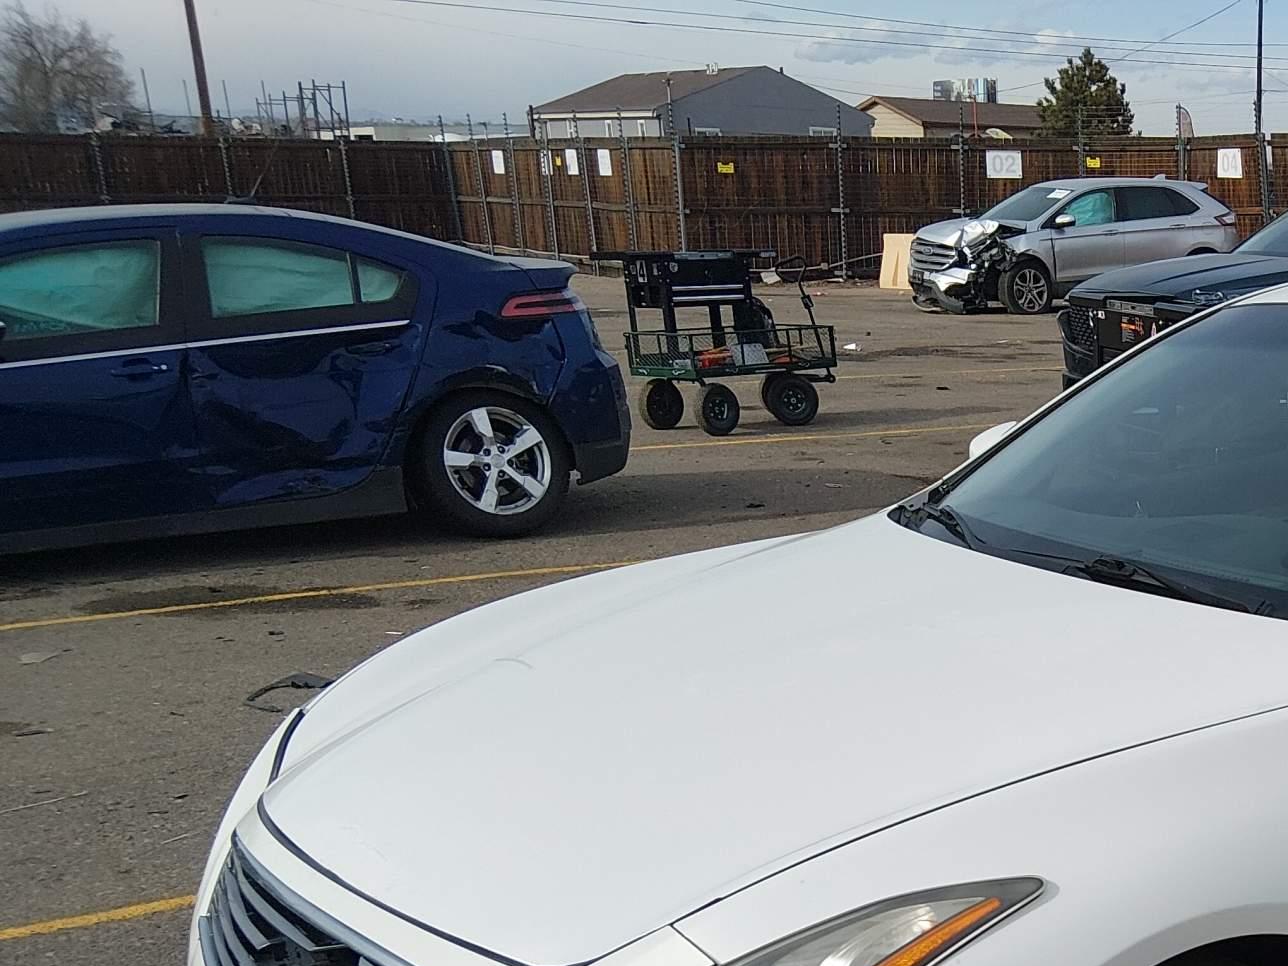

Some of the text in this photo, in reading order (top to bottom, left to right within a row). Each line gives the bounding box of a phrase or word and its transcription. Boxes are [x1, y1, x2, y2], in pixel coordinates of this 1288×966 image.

[992, 154, 1017, 174] 02
[1221, 153, 1239, 173] 04
[638, 261, 646, 282] 4
